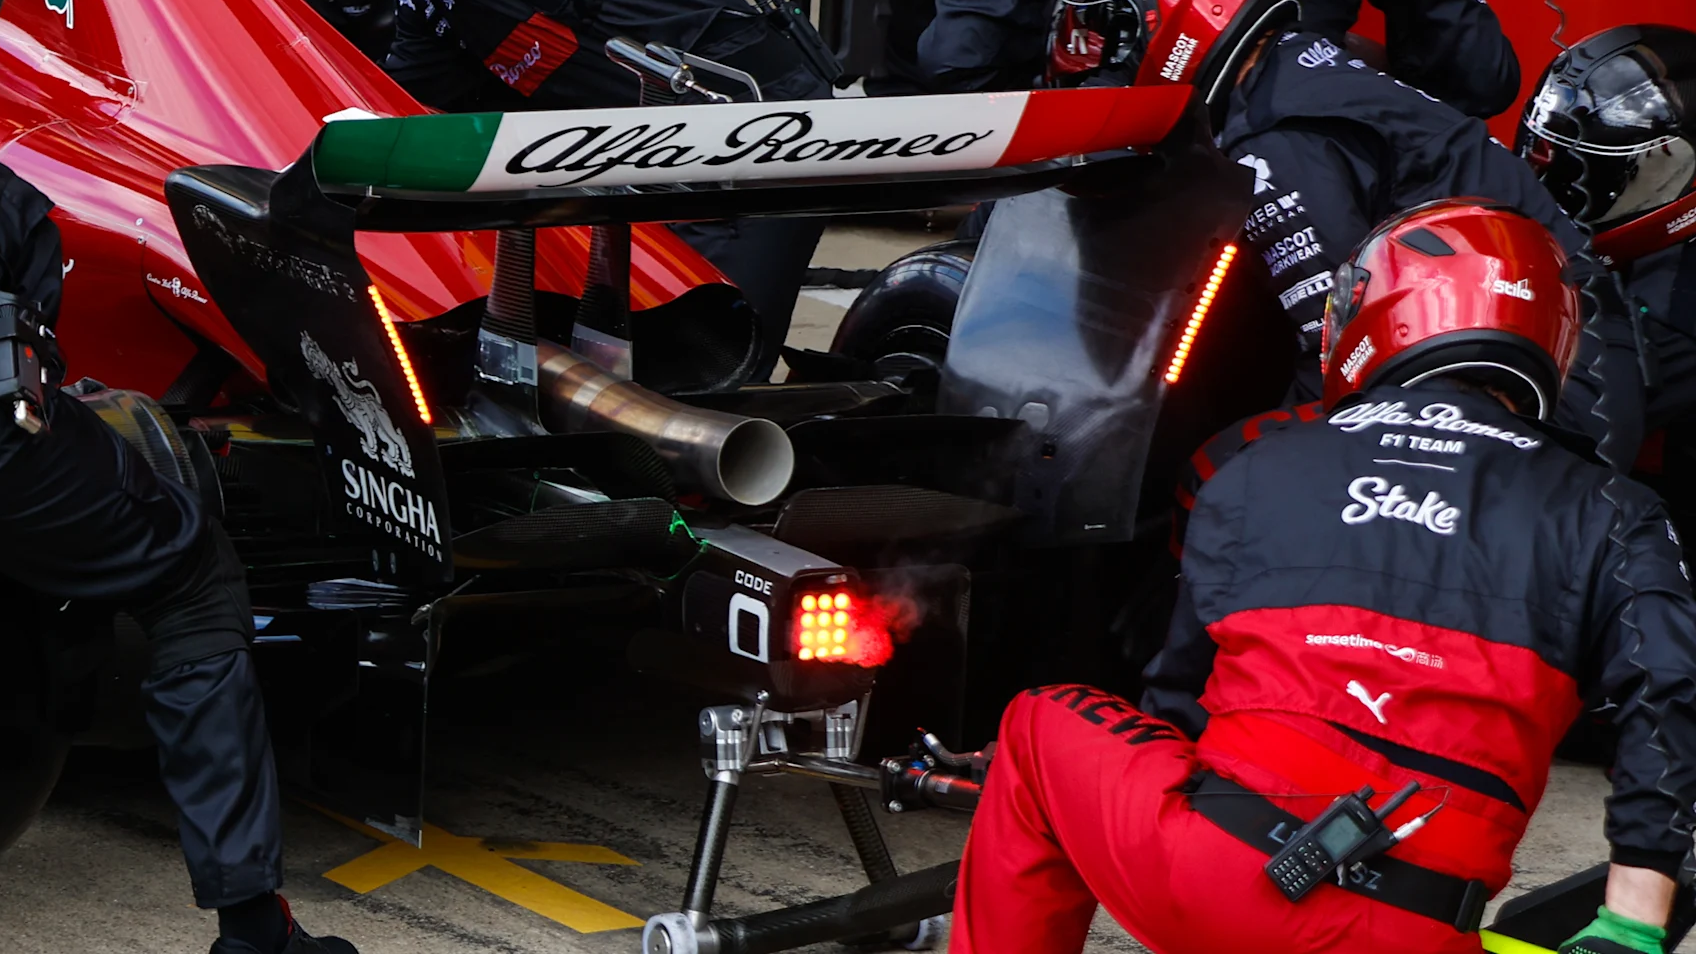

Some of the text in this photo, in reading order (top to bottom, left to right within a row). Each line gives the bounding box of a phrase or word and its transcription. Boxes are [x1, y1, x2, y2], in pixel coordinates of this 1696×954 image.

[1160, 31, 1190, 80] MASCOT
[1169, 37, 1199, 82] WORKWEAR
[1296, 37, 1342, 68] Alfa
[504, 111, 994, 188] Alfa Romeo
[1244, 202, 1278, 232] WEB
[1247, 205, 1306, 241] EYEWEAR
[1261, 226, 1315, 266] MASCOT
[1269, 242, 1323, 277] WORKWEAR
[1277, 270, 1334, 310] PIRELLI
[1492, 278, 1535, 301] Stilo
[1339, 335, 1371, 377] MASCOT
[1328, 401, 1541, 449] Alfa Romeo
[1379, 433, 1466, 454] F1 TEAM
[341, 458, 442, 545] SINGHA
[1340, 476, 1461, 535] Stake
[345, 501, 443, 563] CORPORATION
[735, 570, 773, 595] CODE
